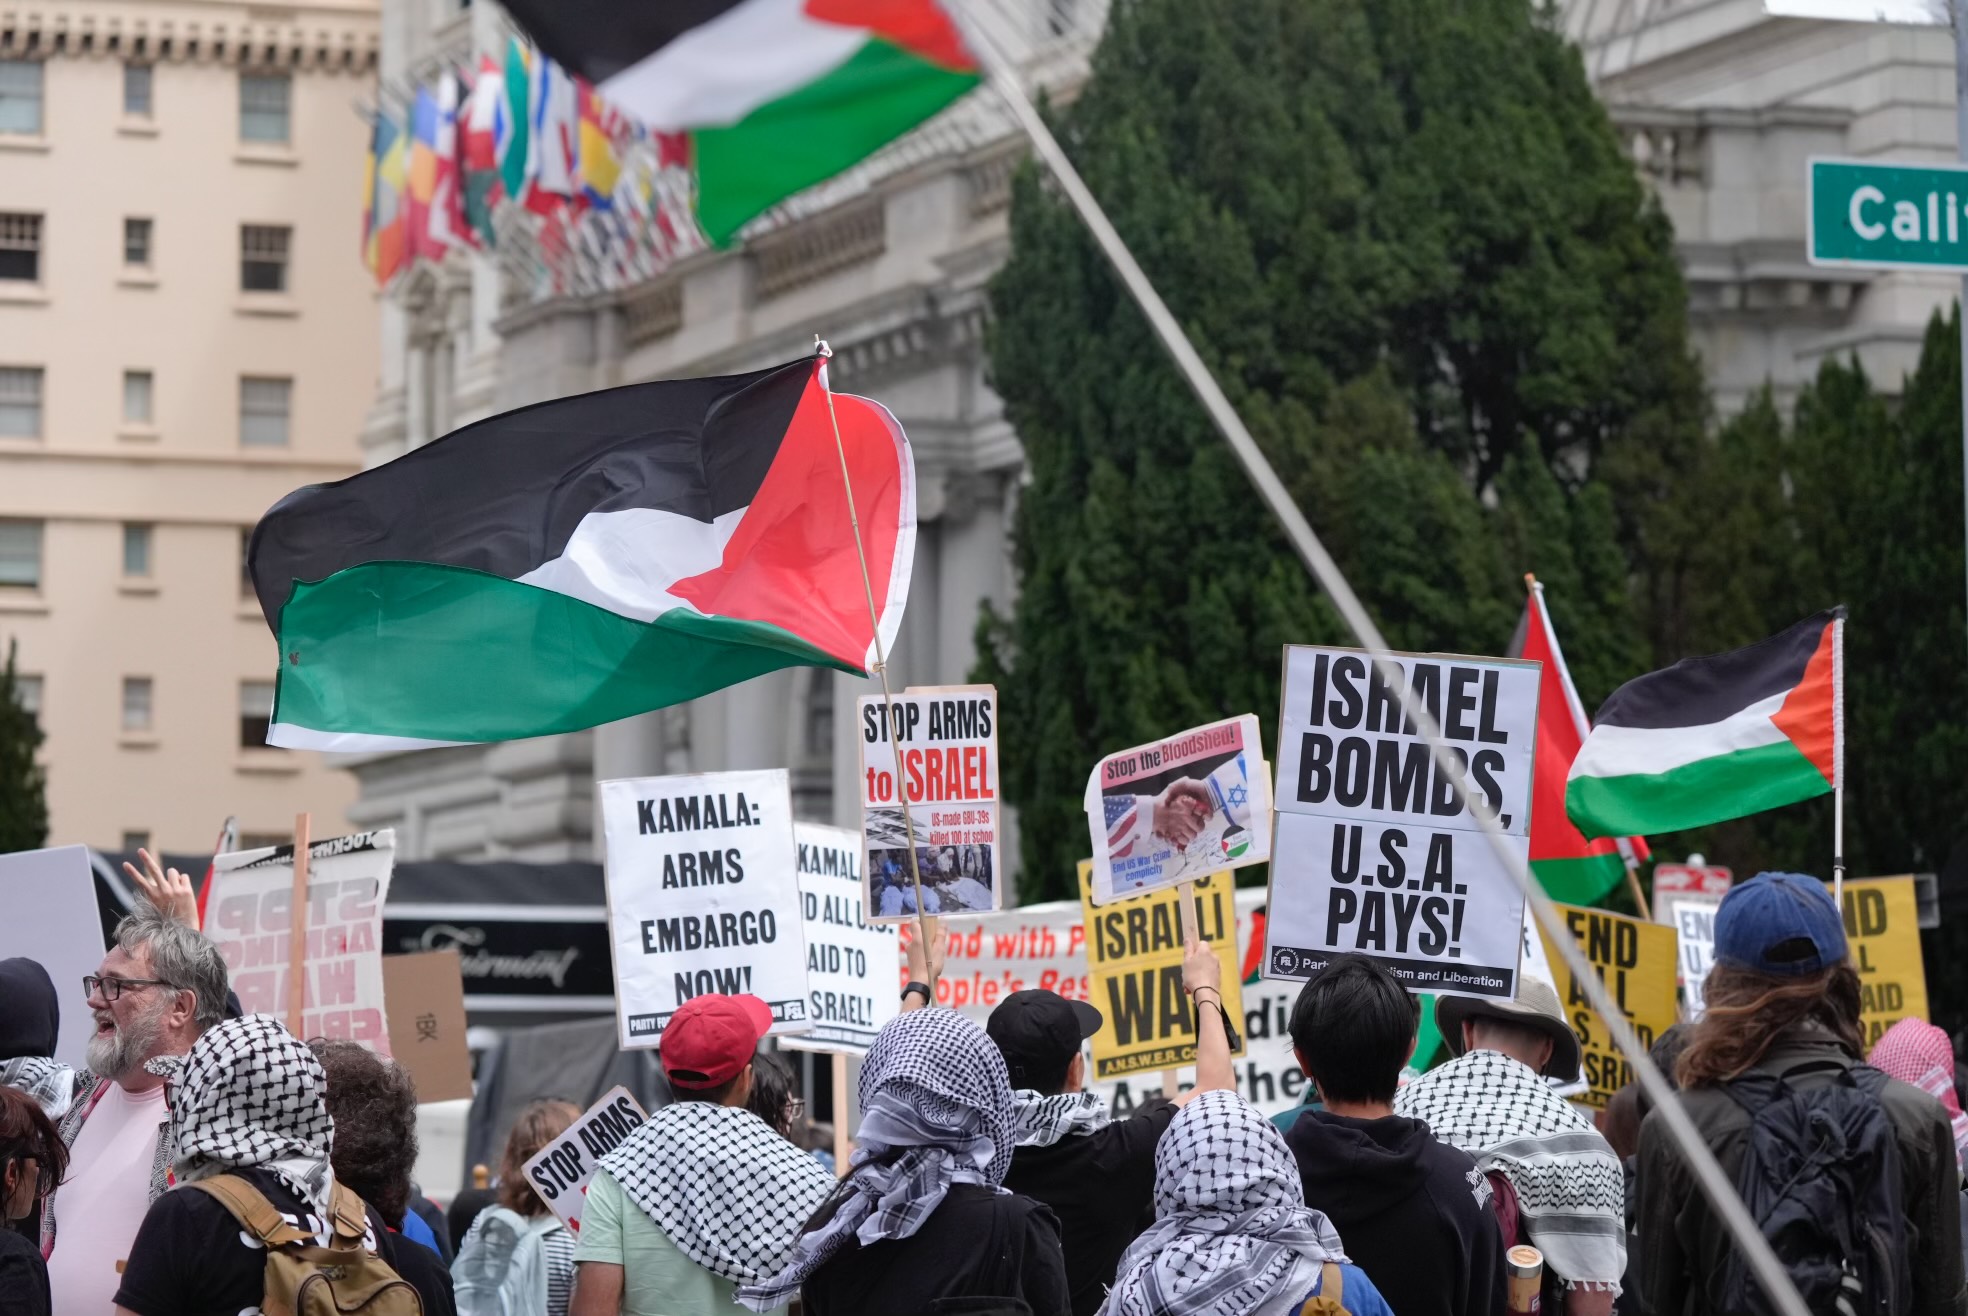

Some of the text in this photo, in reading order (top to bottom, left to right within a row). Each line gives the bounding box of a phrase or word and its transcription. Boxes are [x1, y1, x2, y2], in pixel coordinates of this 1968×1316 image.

[1848, 185, 1968, 243] Cali
[1310, 653, 1508, 745] ISRAEL
[863, 699, 992, 743] STOP ARMS
[1107, 725, 1235, 779] Stop the Bloodshed!
[866, 746, 994, 803] to ISRAEL
[1296, 732, 1512, 830] BOMBS,
[637, 792, 761, 835] KAMALA:
[931, 810, 990, 827] US-made GBU-39s
[929, 830, 950, 846] killed
[951, 830, 963, 844] 100
[964, 830, 971, 843] at
[662, 848, 744, 889] ARMS
[798, 843, 862, 882] KAMAL
[1112, 861, 1126, 873] End
[1127, 858, 1136, 870] US
[1137, 856, 1151, 867] War
[1125, 863, 1163, 882] complicity
[1331, 824, 1468, 895] U.S.A.
[823, 894, 852, 929] ALL
[1325, 887, 1466, 958] PAYS!
[1680, 911, 1714, 942] EN
[641, 909, 776, 954] EMBARGO
[994, 925, 1057, 959] with
[808, 943, 866, 978] AID TO
[1417, 970, 1440, 981] and
[1443, 971, 1504, 988] Liberation
[674, 966, 752, 1006] NOW!
[1862, 981, 1904, 1014] AID
[630, 1014, 670, 1032] PARTY FO
[810, 990, 873, 1027] SRAEL!
[1106, 965, 1195, 1048] WA
[1181, 1046, 1198, 1061] Co
[530, 1096, 644, 1200] STOP ARMS
